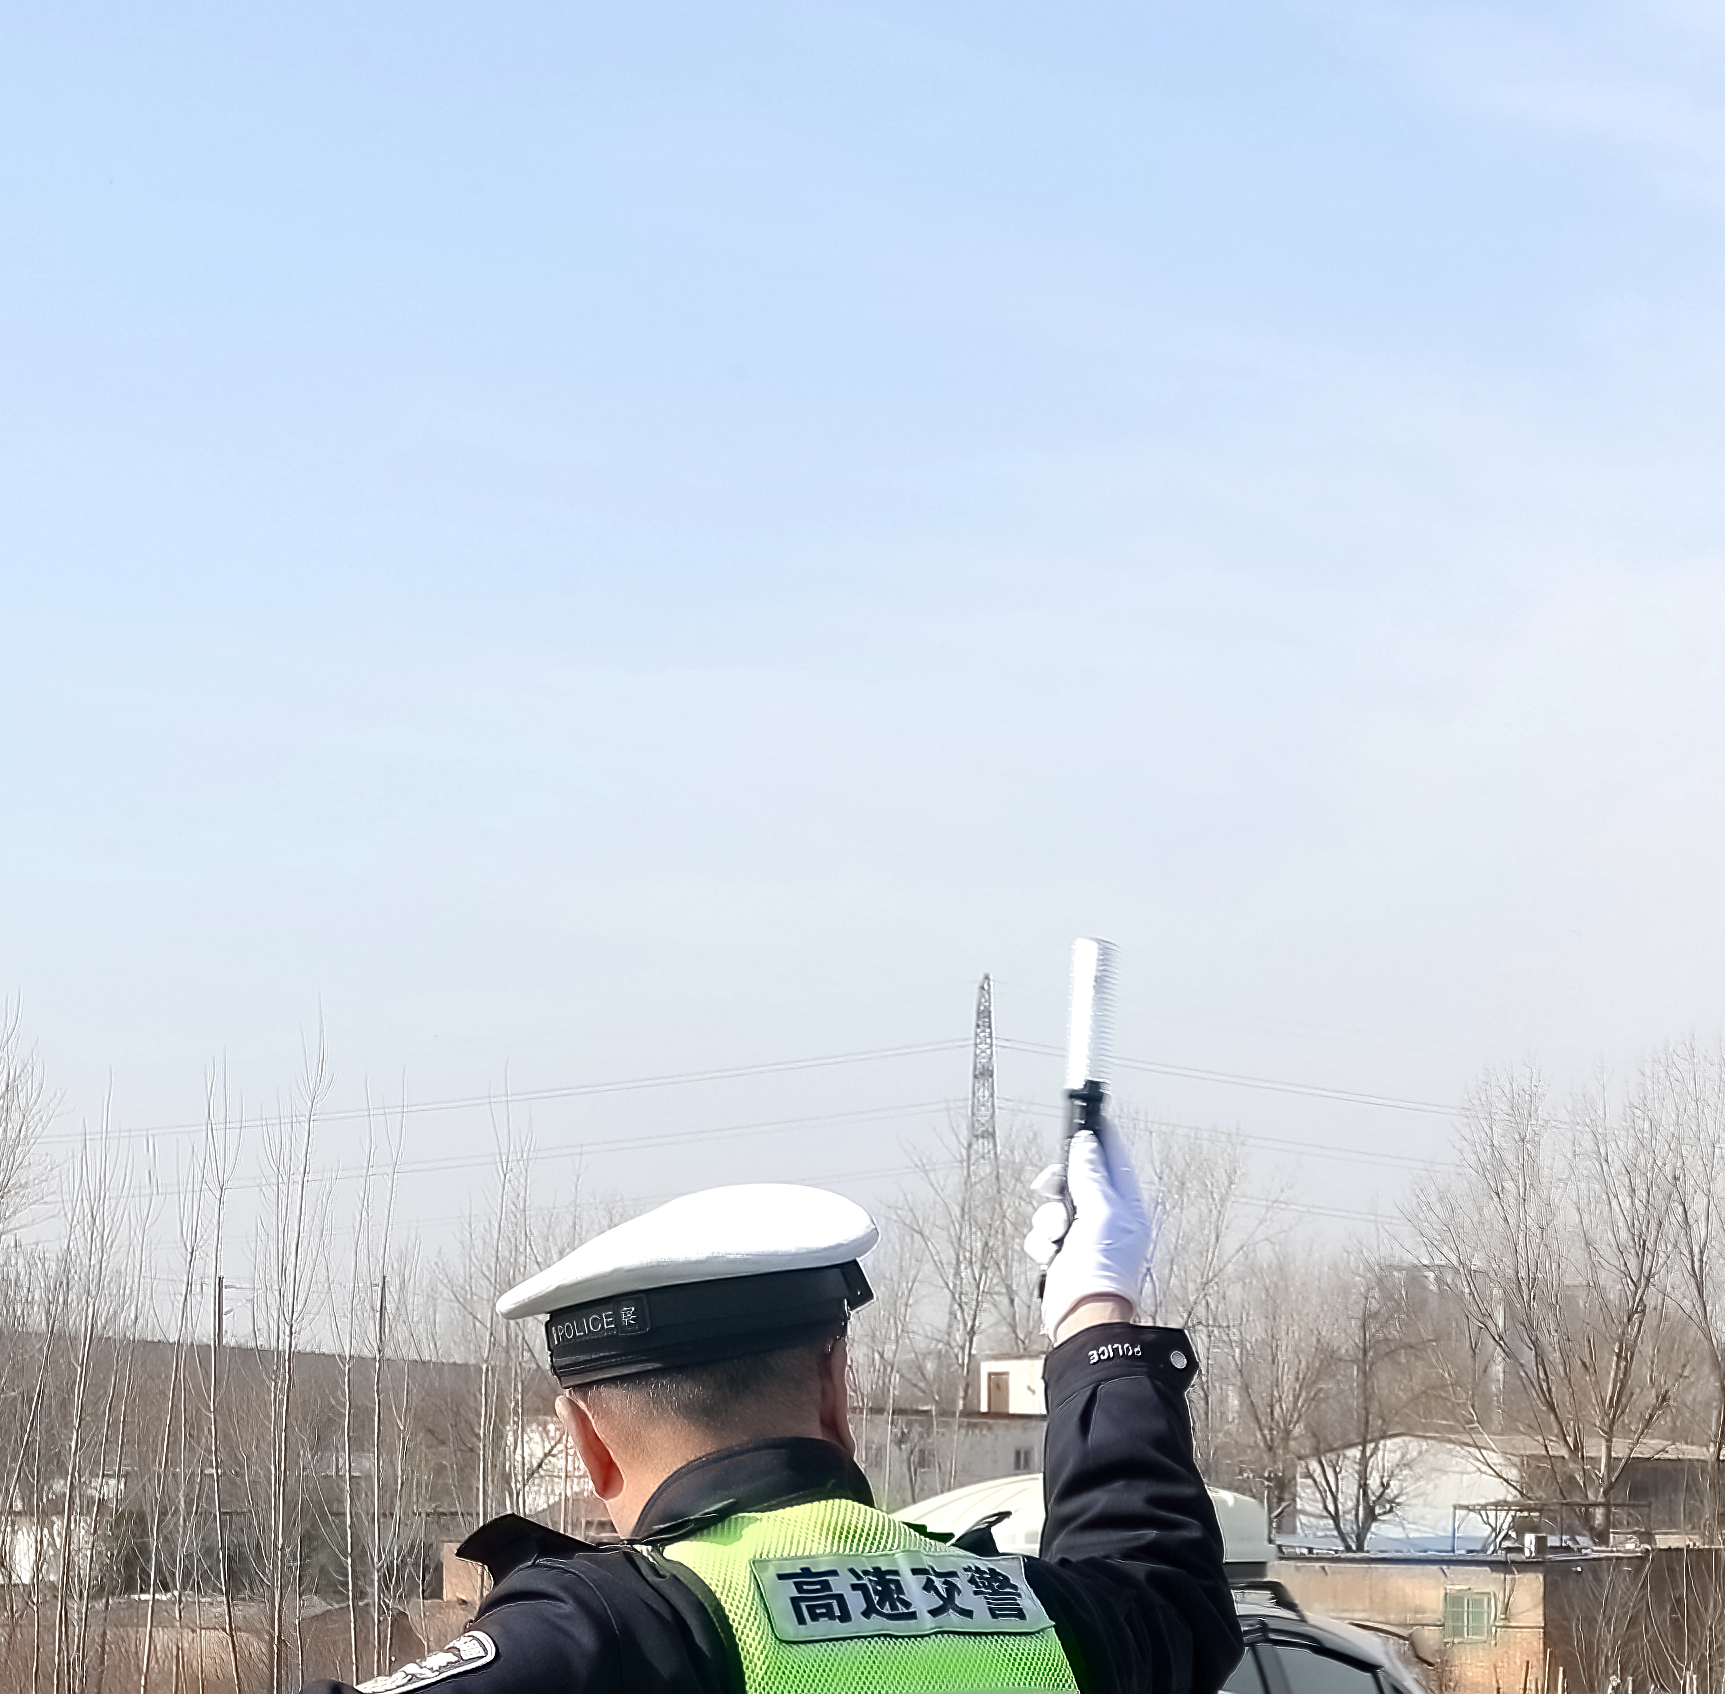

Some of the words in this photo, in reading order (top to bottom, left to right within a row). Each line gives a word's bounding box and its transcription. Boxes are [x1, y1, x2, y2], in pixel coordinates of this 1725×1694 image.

[557, 1311, 615, 1343] POLICE
[1087, 1343, 1142, 1365] POLICE
[776, 1564, 1027, 1626] 高速交警
